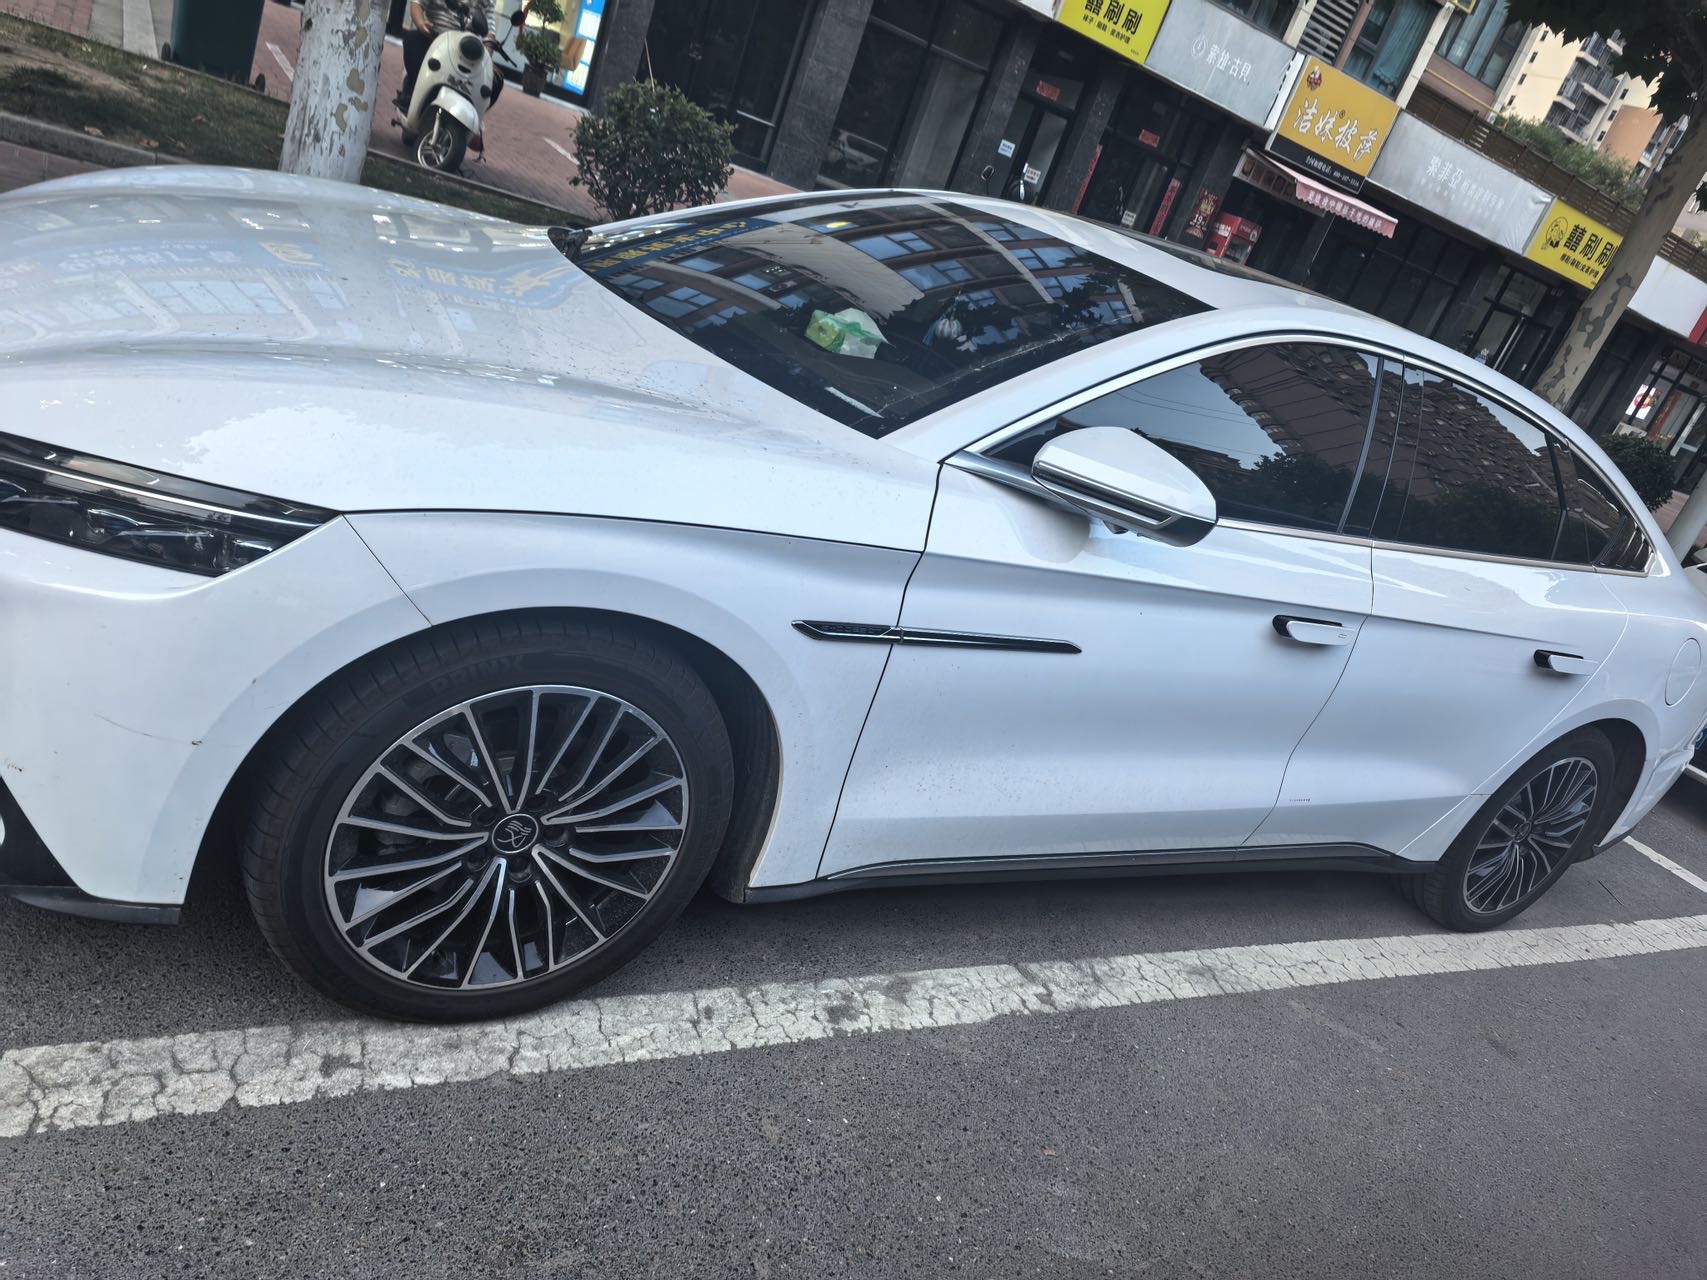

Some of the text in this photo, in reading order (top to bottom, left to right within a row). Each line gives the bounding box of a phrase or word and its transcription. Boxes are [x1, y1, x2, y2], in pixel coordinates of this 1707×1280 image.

[1293, 97, 1378, 160] 洁妹披萨
[1563, 224, 1619, 269] 囍刷刷
